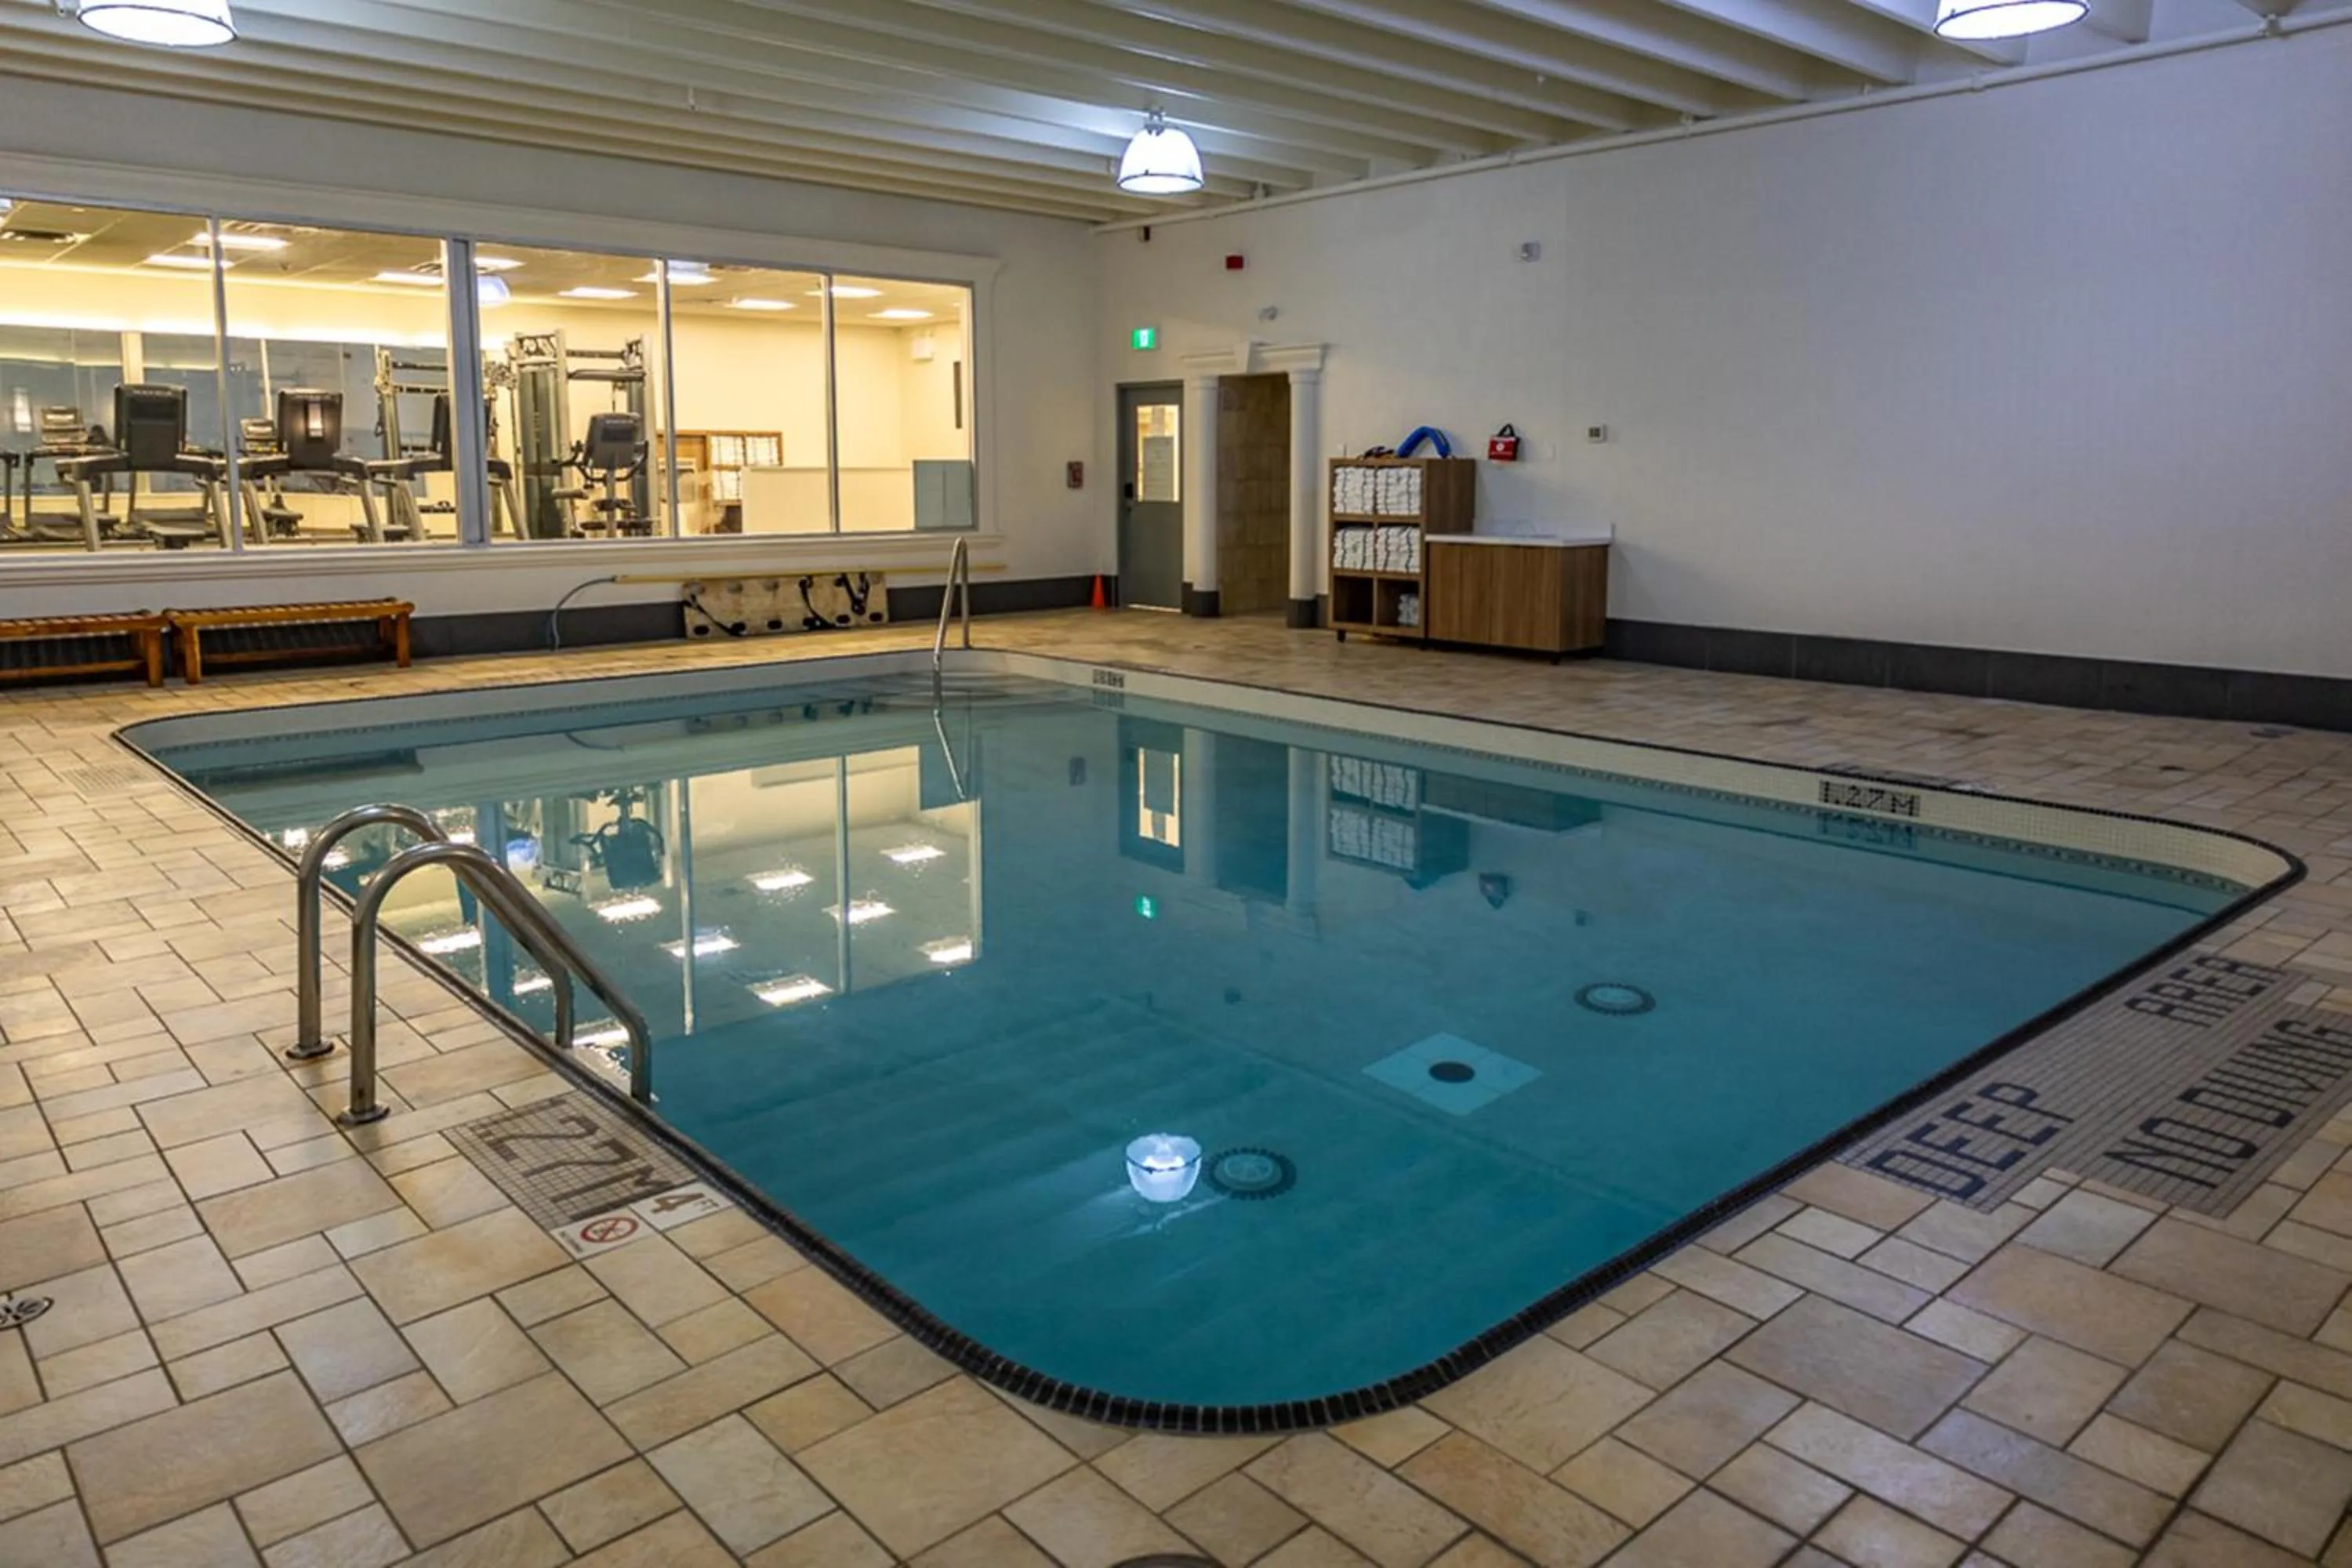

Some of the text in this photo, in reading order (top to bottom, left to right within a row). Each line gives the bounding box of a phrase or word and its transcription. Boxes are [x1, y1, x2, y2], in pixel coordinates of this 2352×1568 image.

[1867, 956, 2285, 1199] DEEP AREA
[2103, 1019, 2352, 1189] NO DIVING
[652, 1192, 705, 1215] 4
